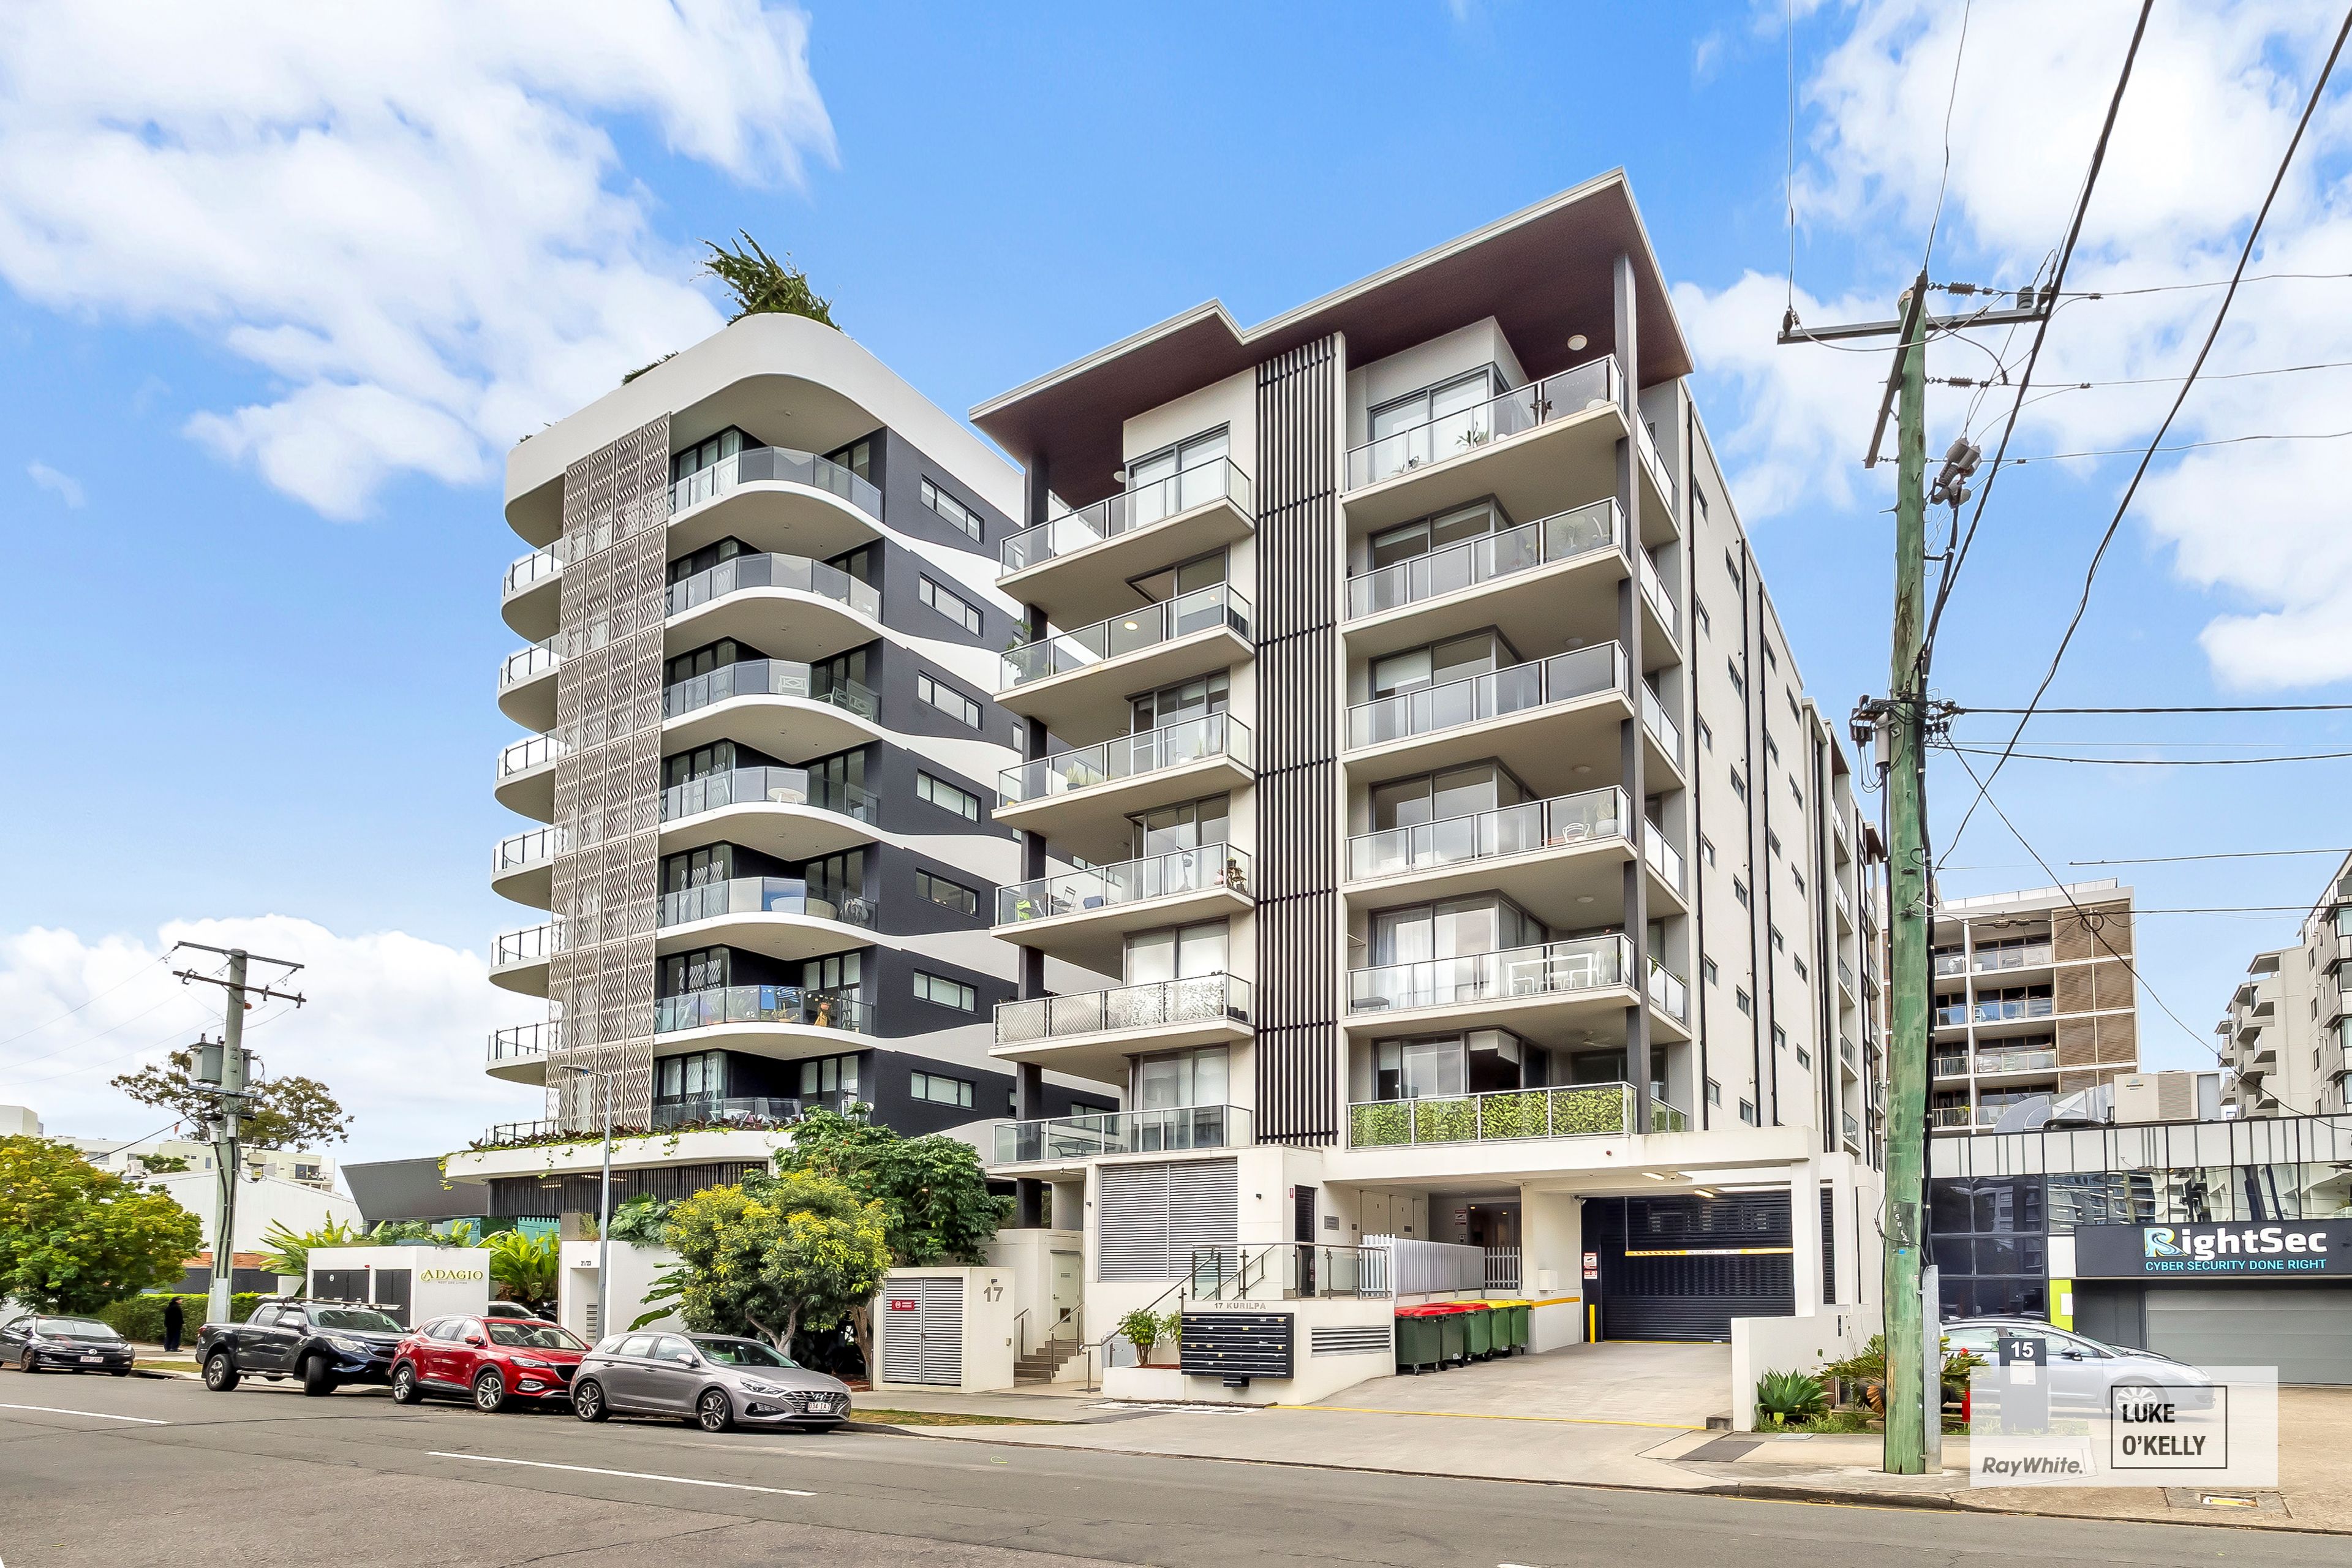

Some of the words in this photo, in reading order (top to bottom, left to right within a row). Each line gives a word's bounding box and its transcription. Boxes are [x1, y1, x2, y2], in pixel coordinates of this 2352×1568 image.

[2144, 1227, 2328, 1261] RightSec
[2146, 1261, 2184, 1271] CYBER
[2187, 1261, 2246, 1270] SECURITY
[2249, 1260, 2285, 1270] DONE
[2288, 1259, 2327, 1269] RIGHT
[421, 1269, 483, 1281] ADAGIO
[984, 1286, 1003, 1302] 17
[2010, 1341, 2034, 1359] 15
